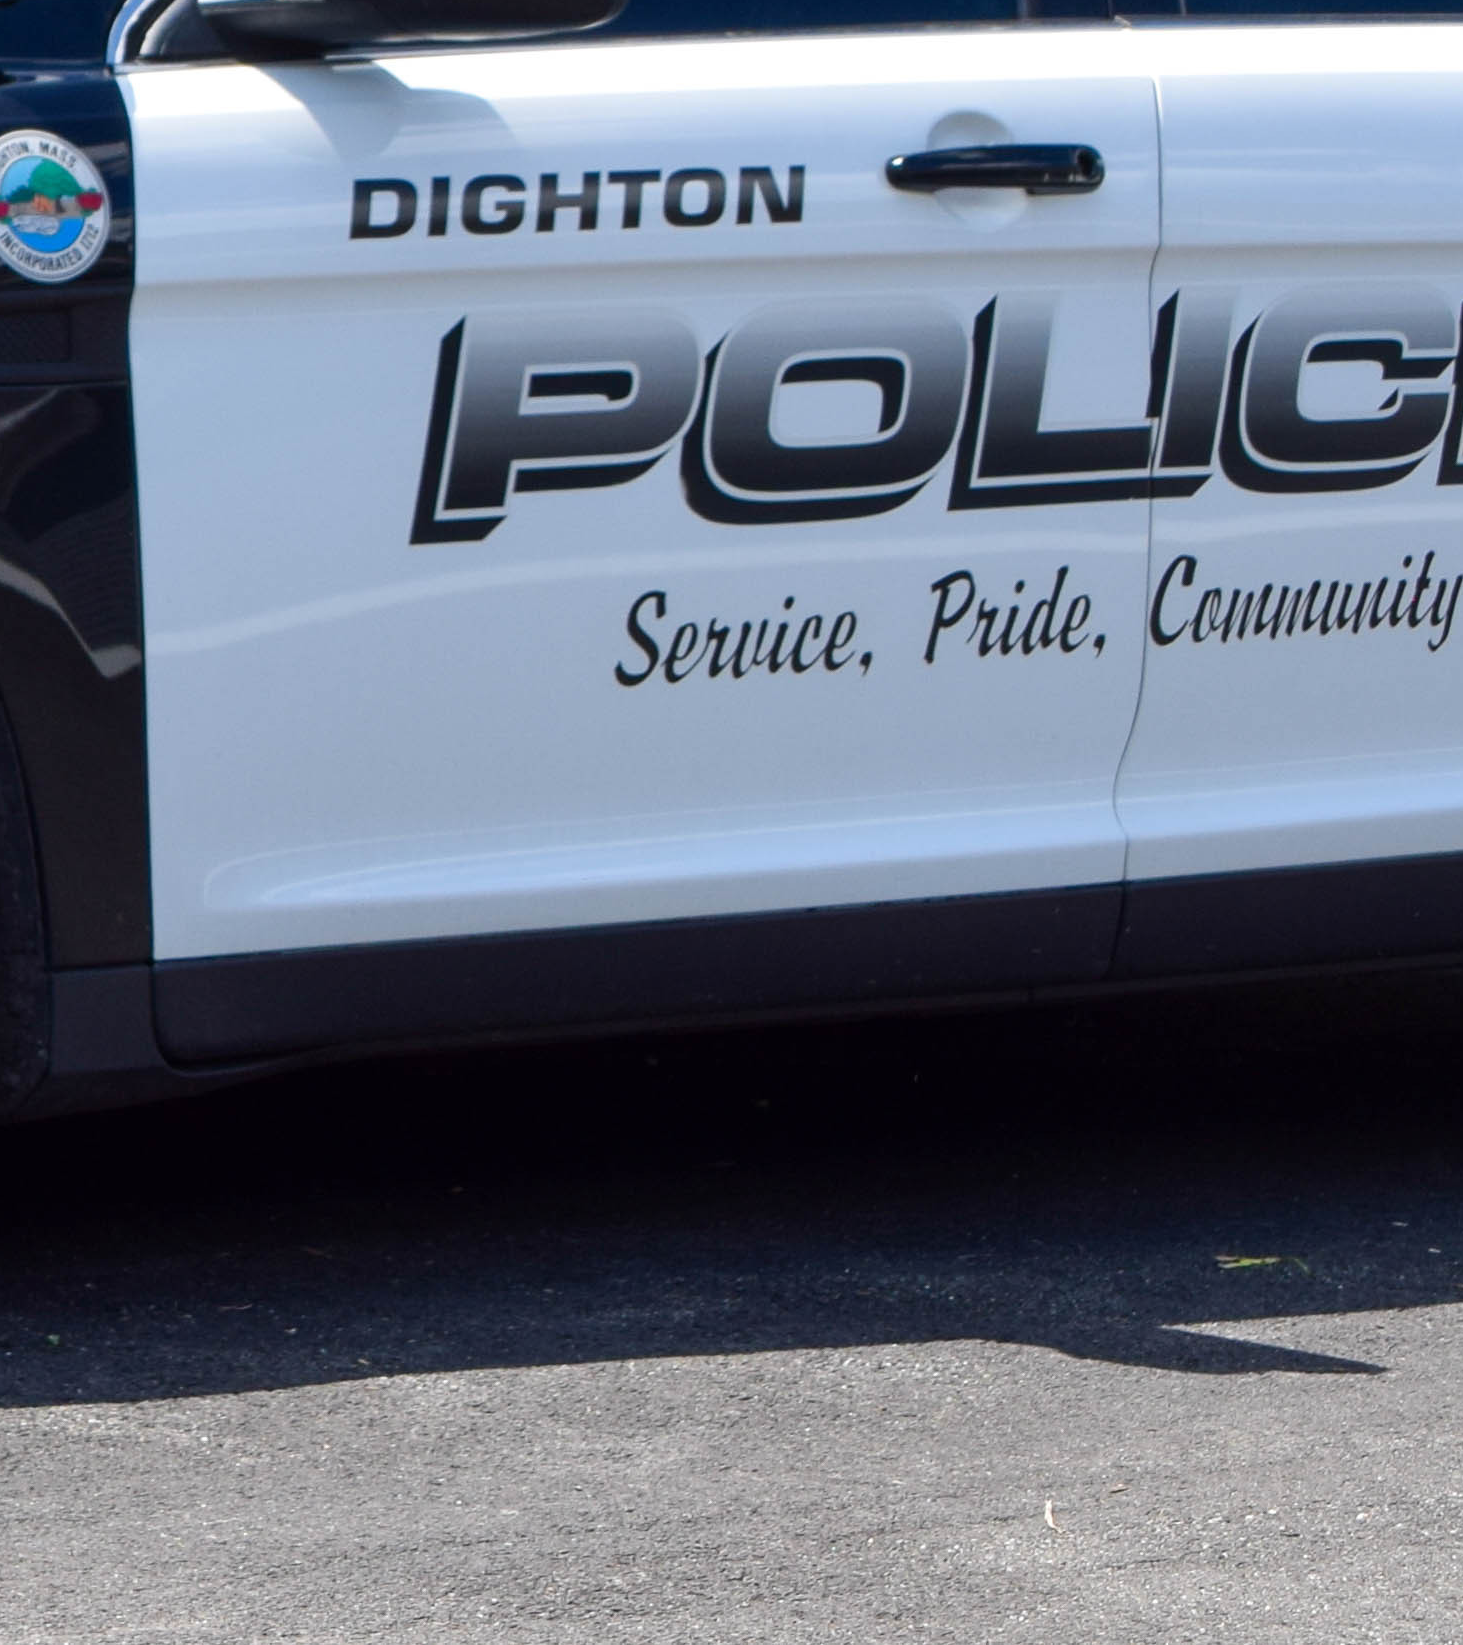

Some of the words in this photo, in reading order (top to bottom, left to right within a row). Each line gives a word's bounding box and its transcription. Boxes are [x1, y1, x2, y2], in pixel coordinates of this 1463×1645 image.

[349, 165, 806, 241] DIGHTON
[614, 589, 875, 687] Service,
[923, 565, 1109, 664] Pride,
